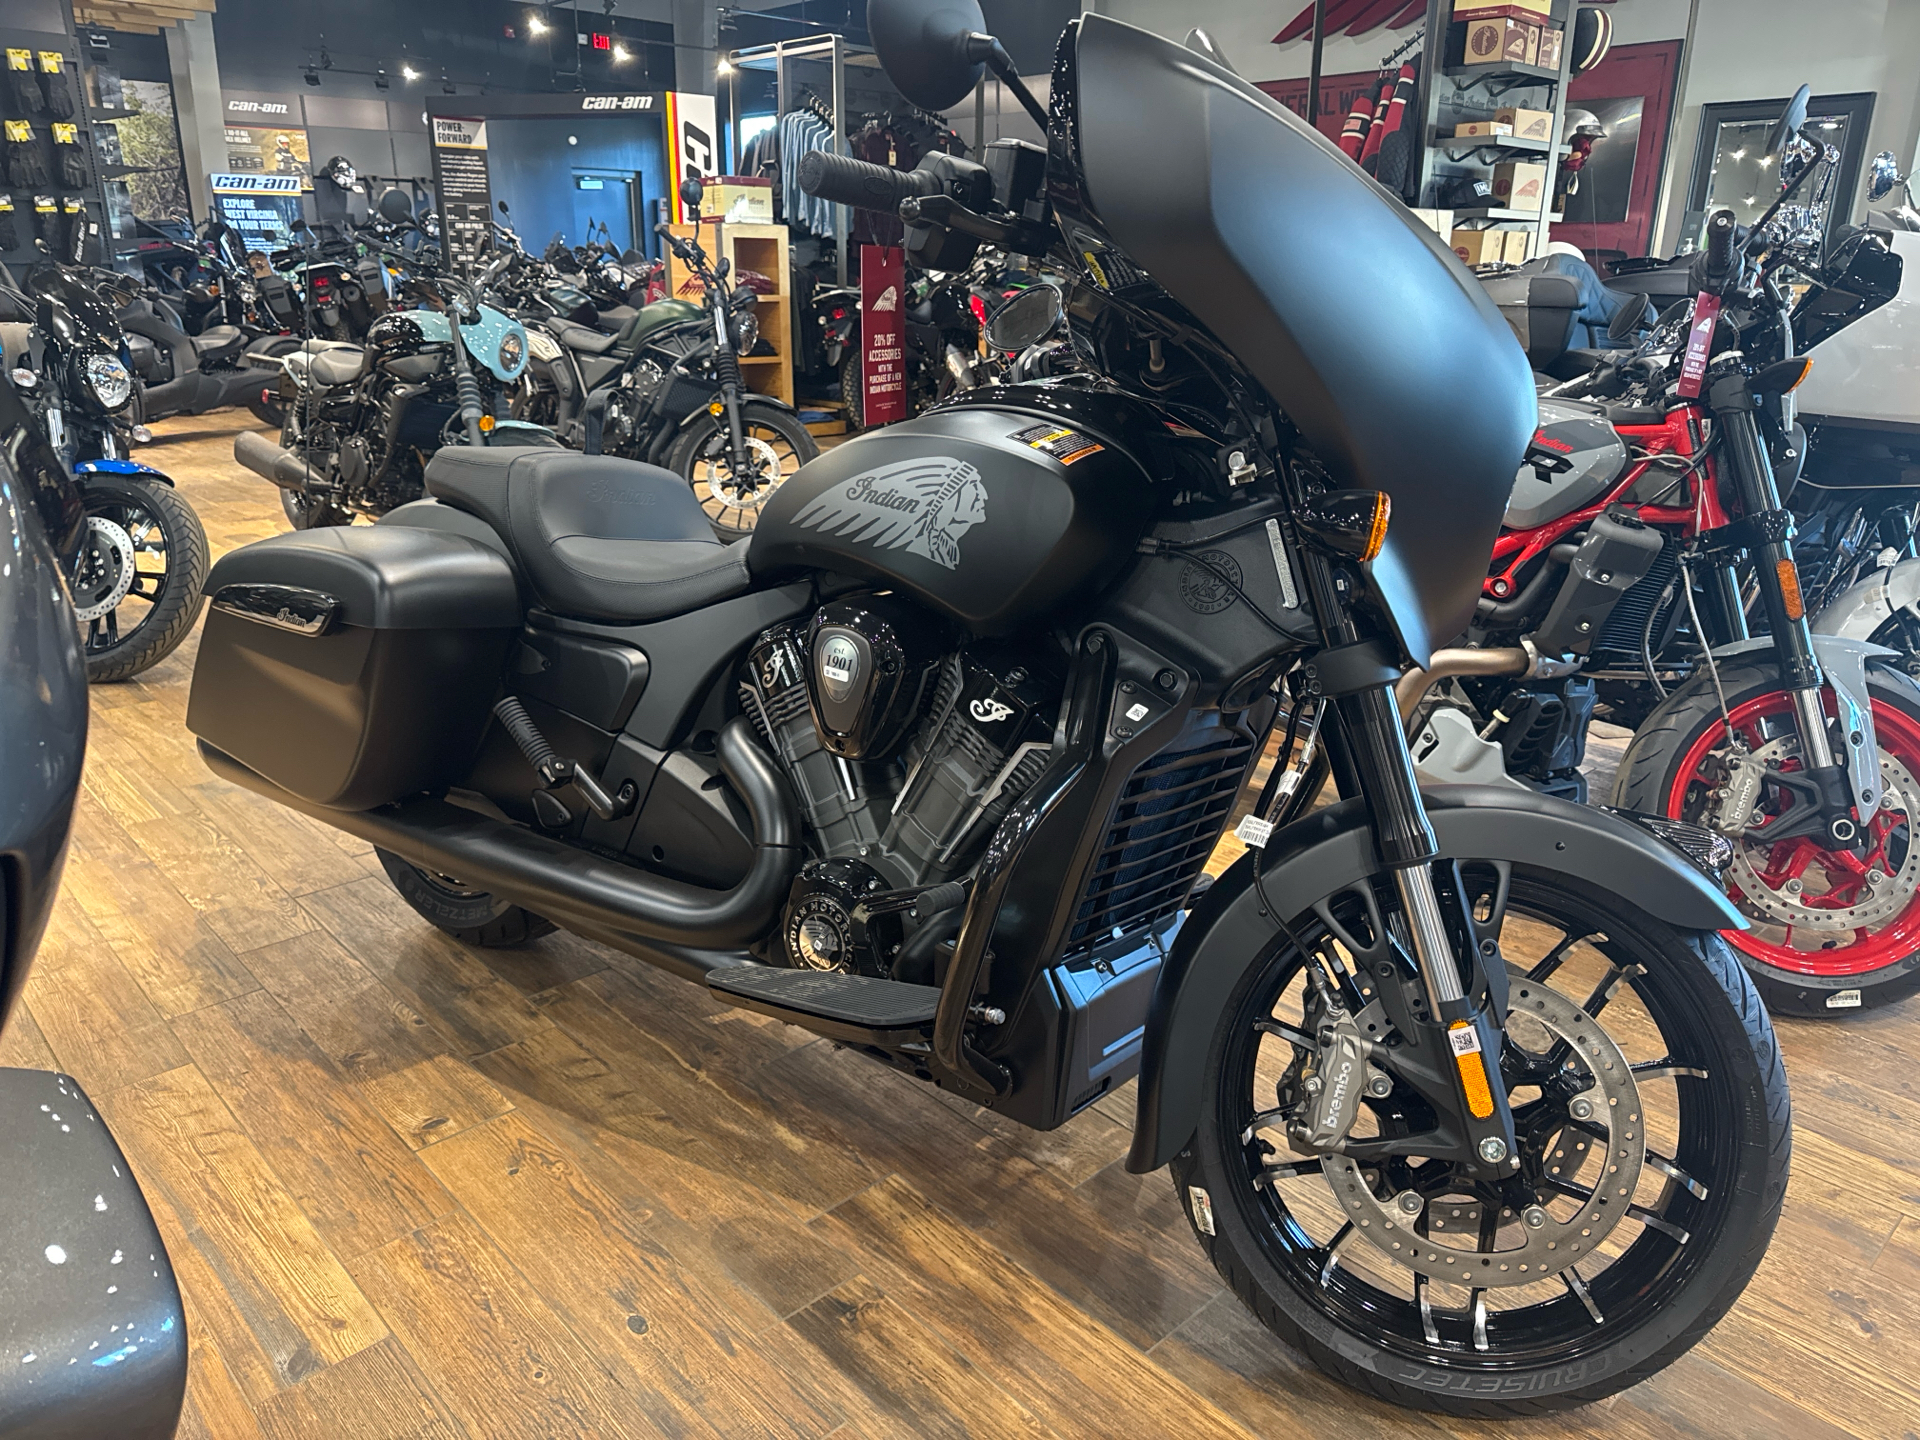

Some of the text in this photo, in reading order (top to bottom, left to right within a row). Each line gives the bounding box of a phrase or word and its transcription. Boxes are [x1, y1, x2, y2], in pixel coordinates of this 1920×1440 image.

[228, 100, 288, 114] can-am
[582, 95, 653, 110] can-am
[437, 132, 473, 145] FORWARD
[215, 175, 298, 190] can-am
[222, 198, 256, 209] EXPLORE
[224, 209, 279, 220] WEST VIRGINIA
[238, 219, 260, 230] YOUR
[259, 220, 284, 230] TERMS
[873, 332, 896, 347] 20% OFF
[868, 348, 902, 363] ACCESSORIES
[877, 364, 887, 373] WITH
[869, 374, 887, 385] PURCHASE
[1533, 429, 1574, 454] Indian
[586, 479, 656, 506] Indian
[846, 476, 920, 514] Indian
[277, 606, 307, 628] Indian
[826, 654, 853, 671] 1901
[1731, 778, 1753, 820] brembo
[414, 889, 488, 920] METZELER
[789, 906, 808, 958] INDIAN
[1321, 1061, 1352, 1129] brembo
[1398, 1354, 1612, 1393] CRUISETEC
